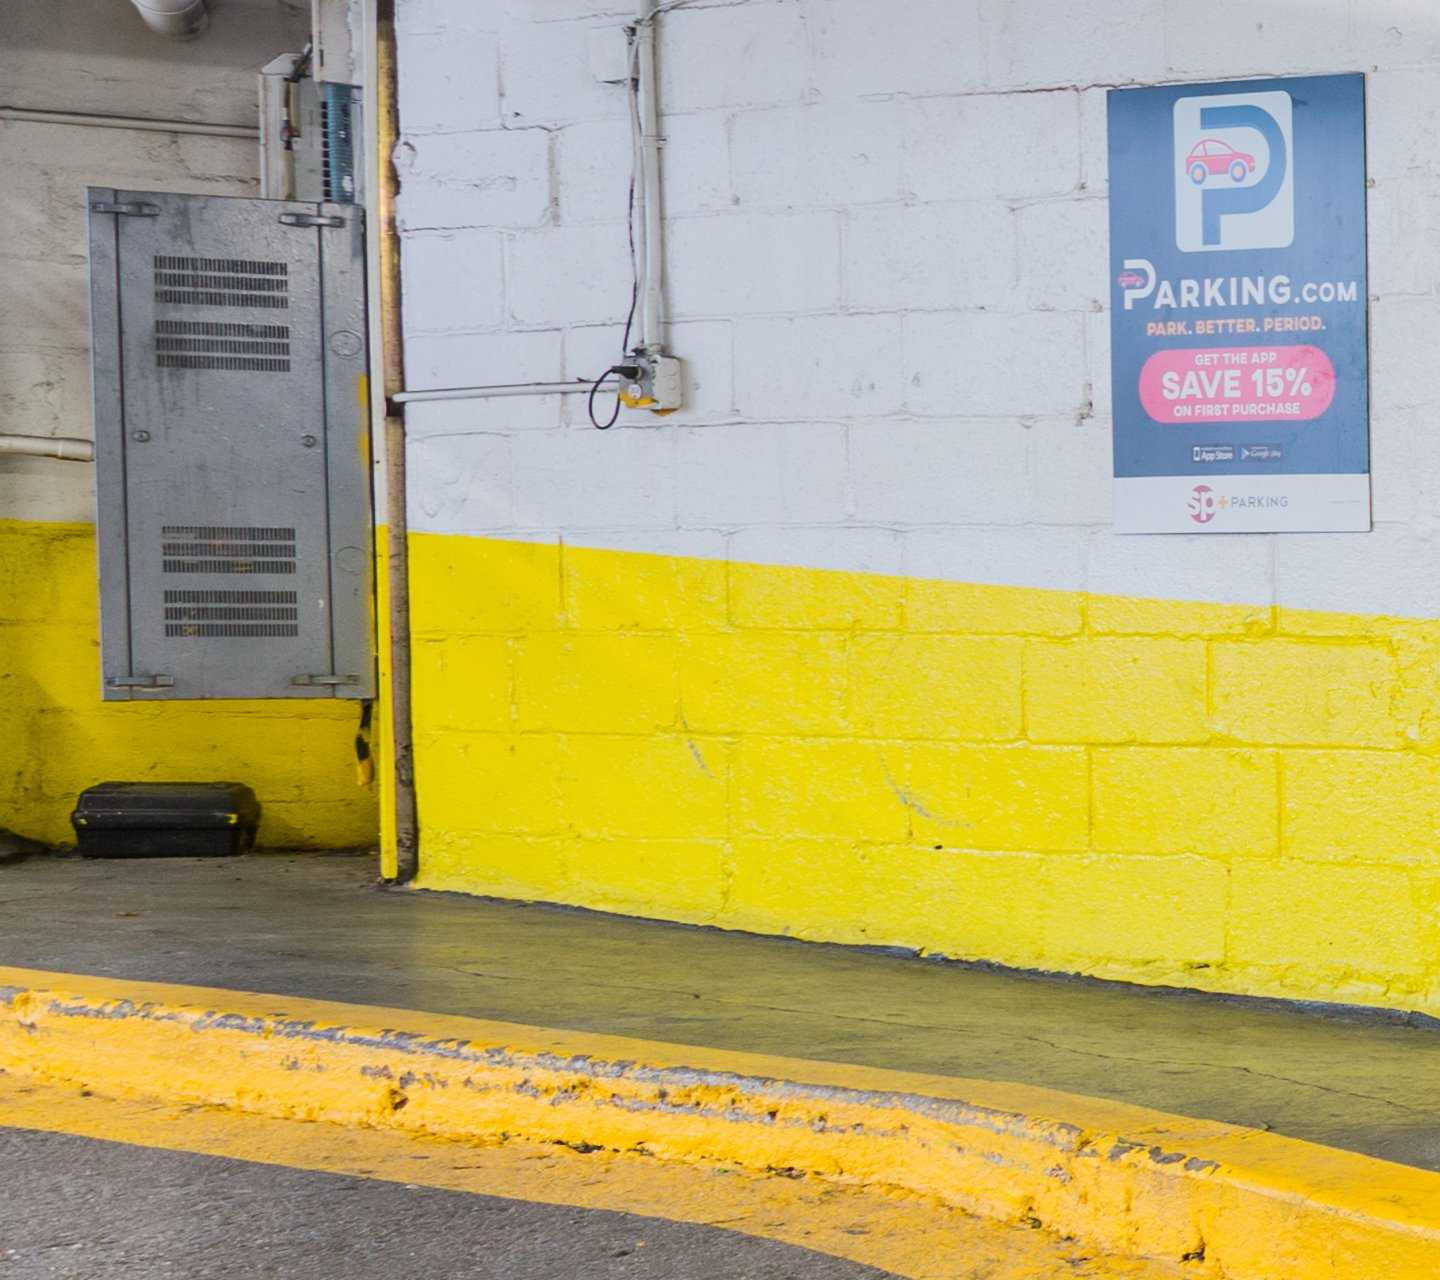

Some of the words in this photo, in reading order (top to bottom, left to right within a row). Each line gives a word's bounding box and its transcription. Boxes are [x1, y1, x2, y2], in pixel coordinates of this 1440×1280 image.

[1146, 320, 1193, 336] PARK.
[1195, 318, 1261, 335] BETTER.
[1263, 315, 1327, 332] PERIOD.
[1194, 353, 1221, 366] GET
[1222, 352, 1248, 365] THE
[1251, 351, 1278, 364] APP
[1161, 369, 1242, 401] SAVE
[1251, 367, 1313, 398] 15%
[1173, 404, 1192, 418] ON
[1194, 403, 1230, 416] FIRST
[1232, 402, 1301, 416] PURCHASE
[1201, 451, 1215, 461] App
[1215, 450, 1234, 460] Store
[1231, 495, 1289, 508] PARKING
